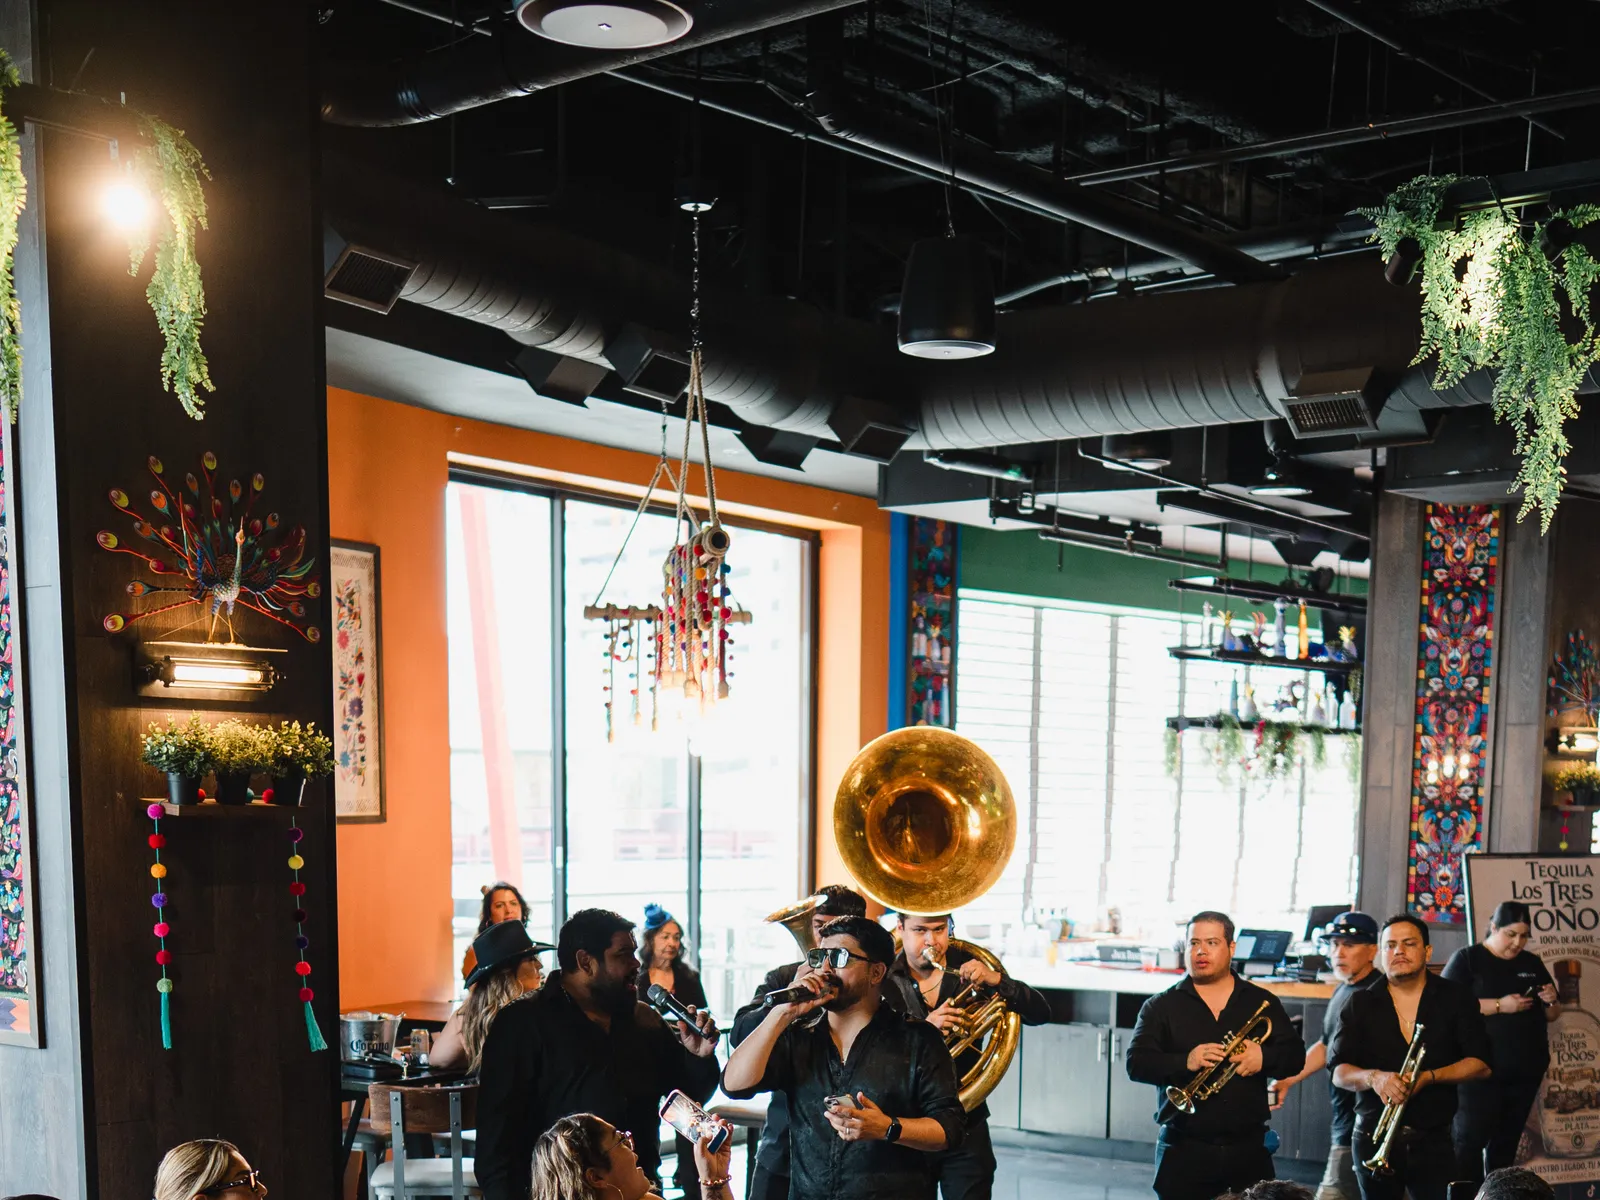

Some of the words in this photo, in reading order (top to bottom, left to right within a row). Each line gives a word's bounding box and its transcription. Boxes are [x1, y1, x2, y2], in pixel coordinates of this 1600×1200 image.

[1525, 861, 1594, 880] TEQUILA
[1511, 880, 1543, 900] LOS
[1543, 880, 1594, 907] TRES
[1527, 902, 1600, 938] OÑO
[1540, 935, 1559, 944] 100%
[1561, 935, 1570, 944] DE
[1571, 934, 1595, 944] AGAVE
[351, 1039, 389, 1054] Corona
